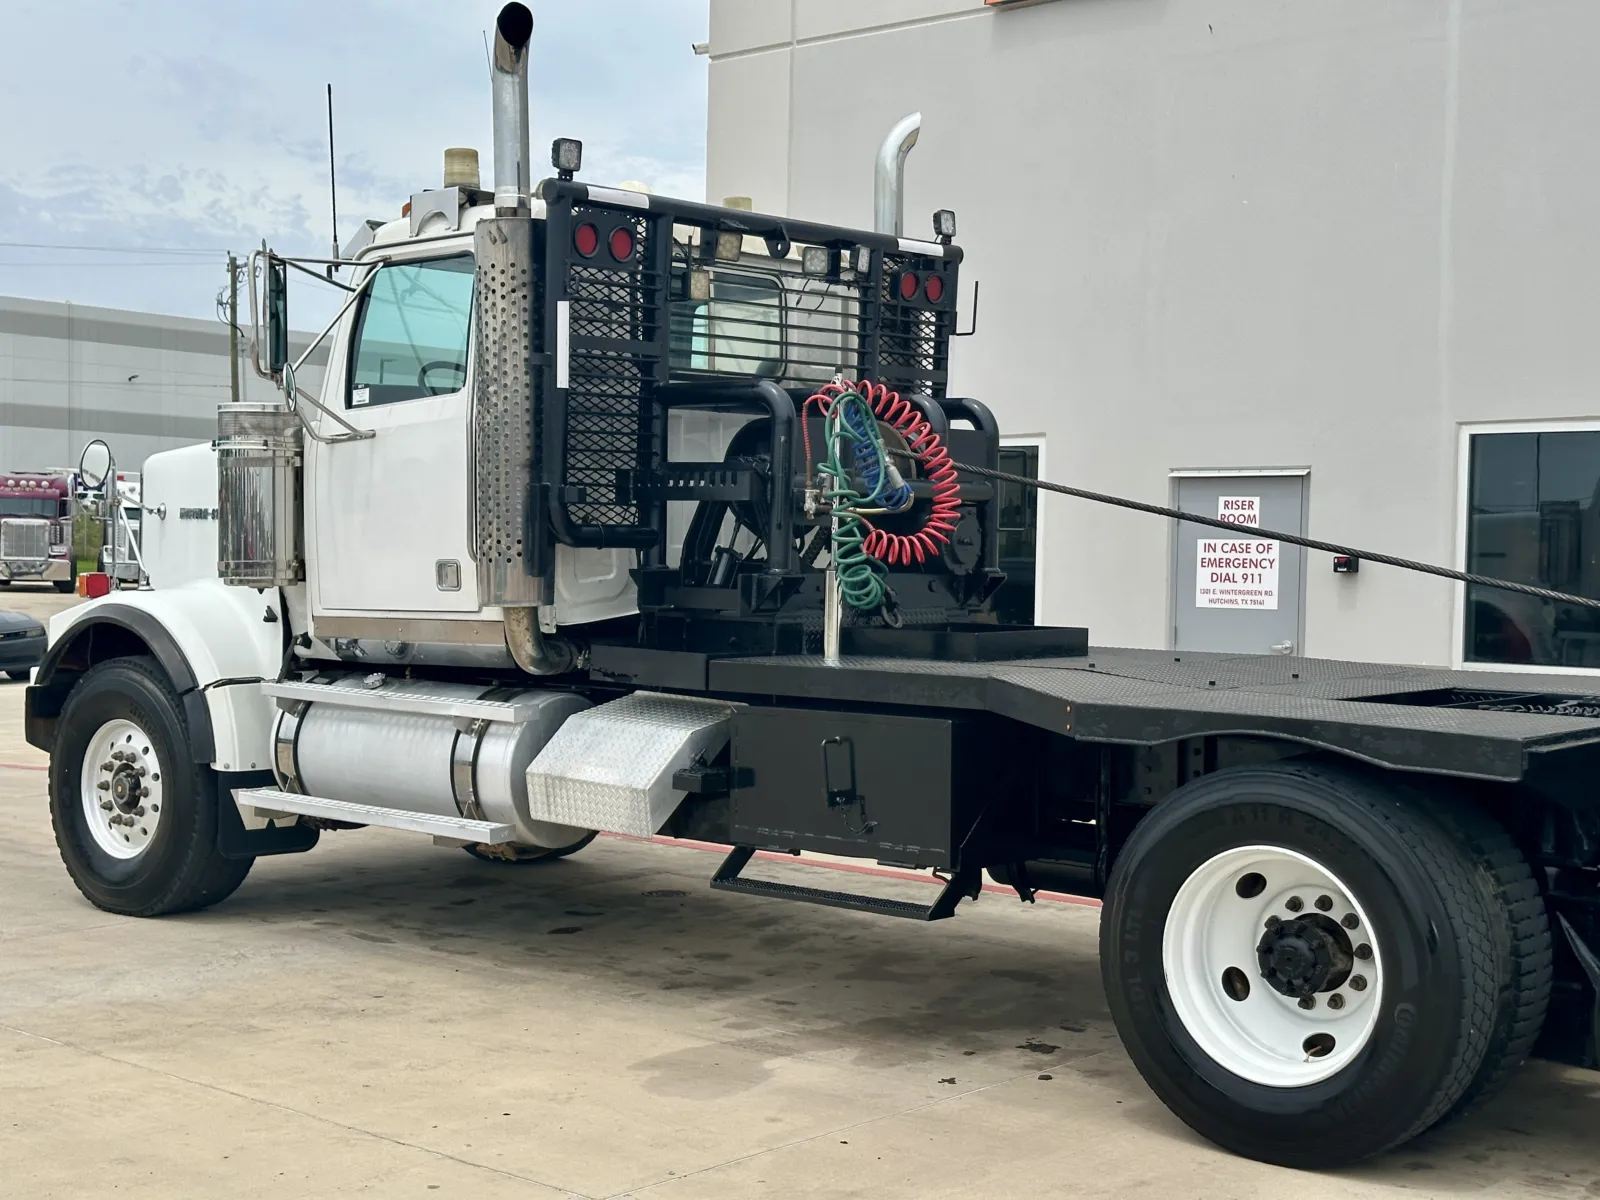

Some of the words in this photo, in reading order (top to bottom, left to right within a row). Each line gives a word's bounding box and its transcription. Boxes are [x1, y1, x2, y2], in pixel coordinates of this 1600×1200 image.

[1223, 500, 1254, 510] RISER
[1220, 513, 1257, 524] ROOM
[1203, 543, 1217, 553] IN
[1221, 543, 1251, 554] CASE
[1256, 543, 1273, 554] OF
[1200, 557, 1275, 569] EMERGENCY
[1210, 572, 1238, 583] DIAL
[1241, 573, 1262, 584] 911
[1219, 589, 1263, 597] WINTERGREEN
